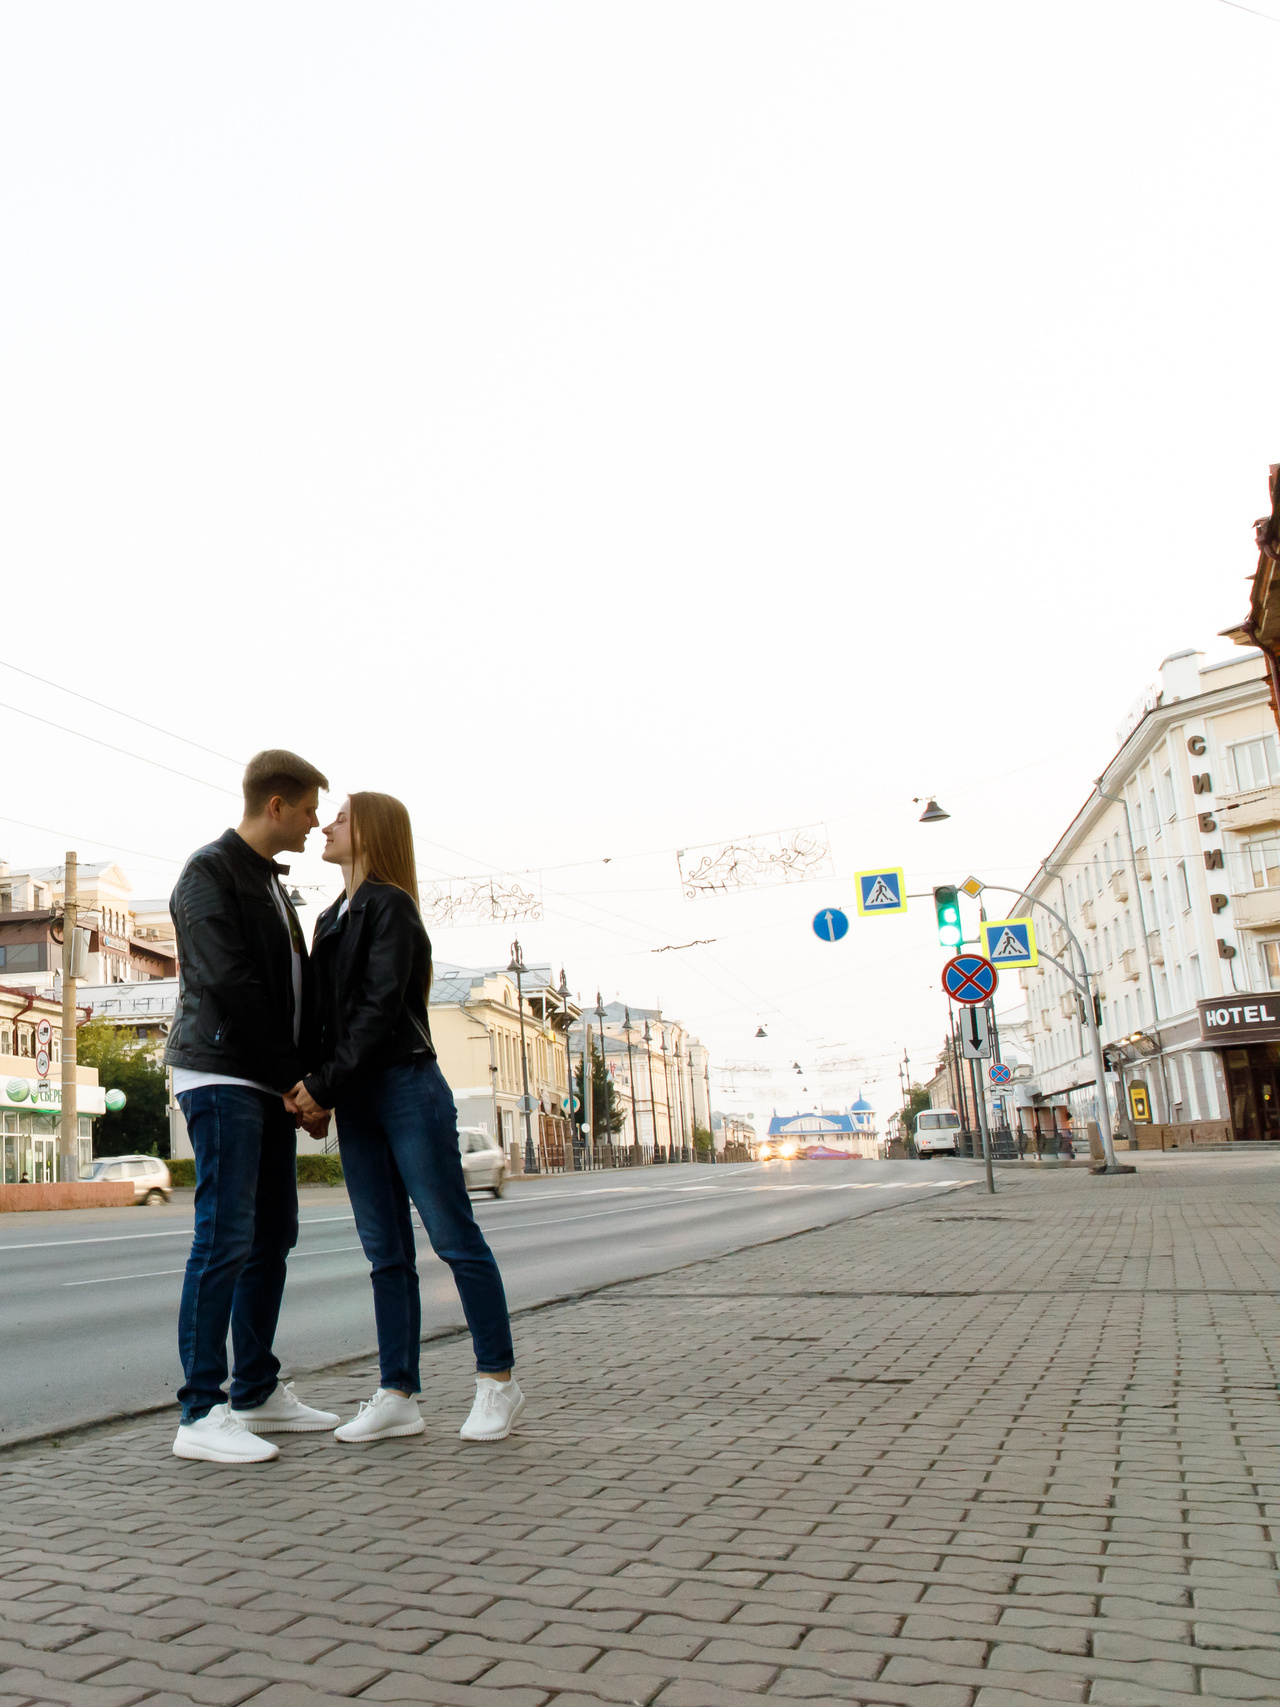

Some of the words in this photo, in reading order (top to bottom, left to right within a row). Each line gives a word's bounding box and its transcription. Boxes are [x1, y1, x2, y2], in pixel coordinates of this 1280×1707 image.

[1187, 735, 1237, 959] СИБИРЬ
[1205, 1004, 1276, 1027] HOTEL
[40, 1088, 62, 1103] СБЕРБ
